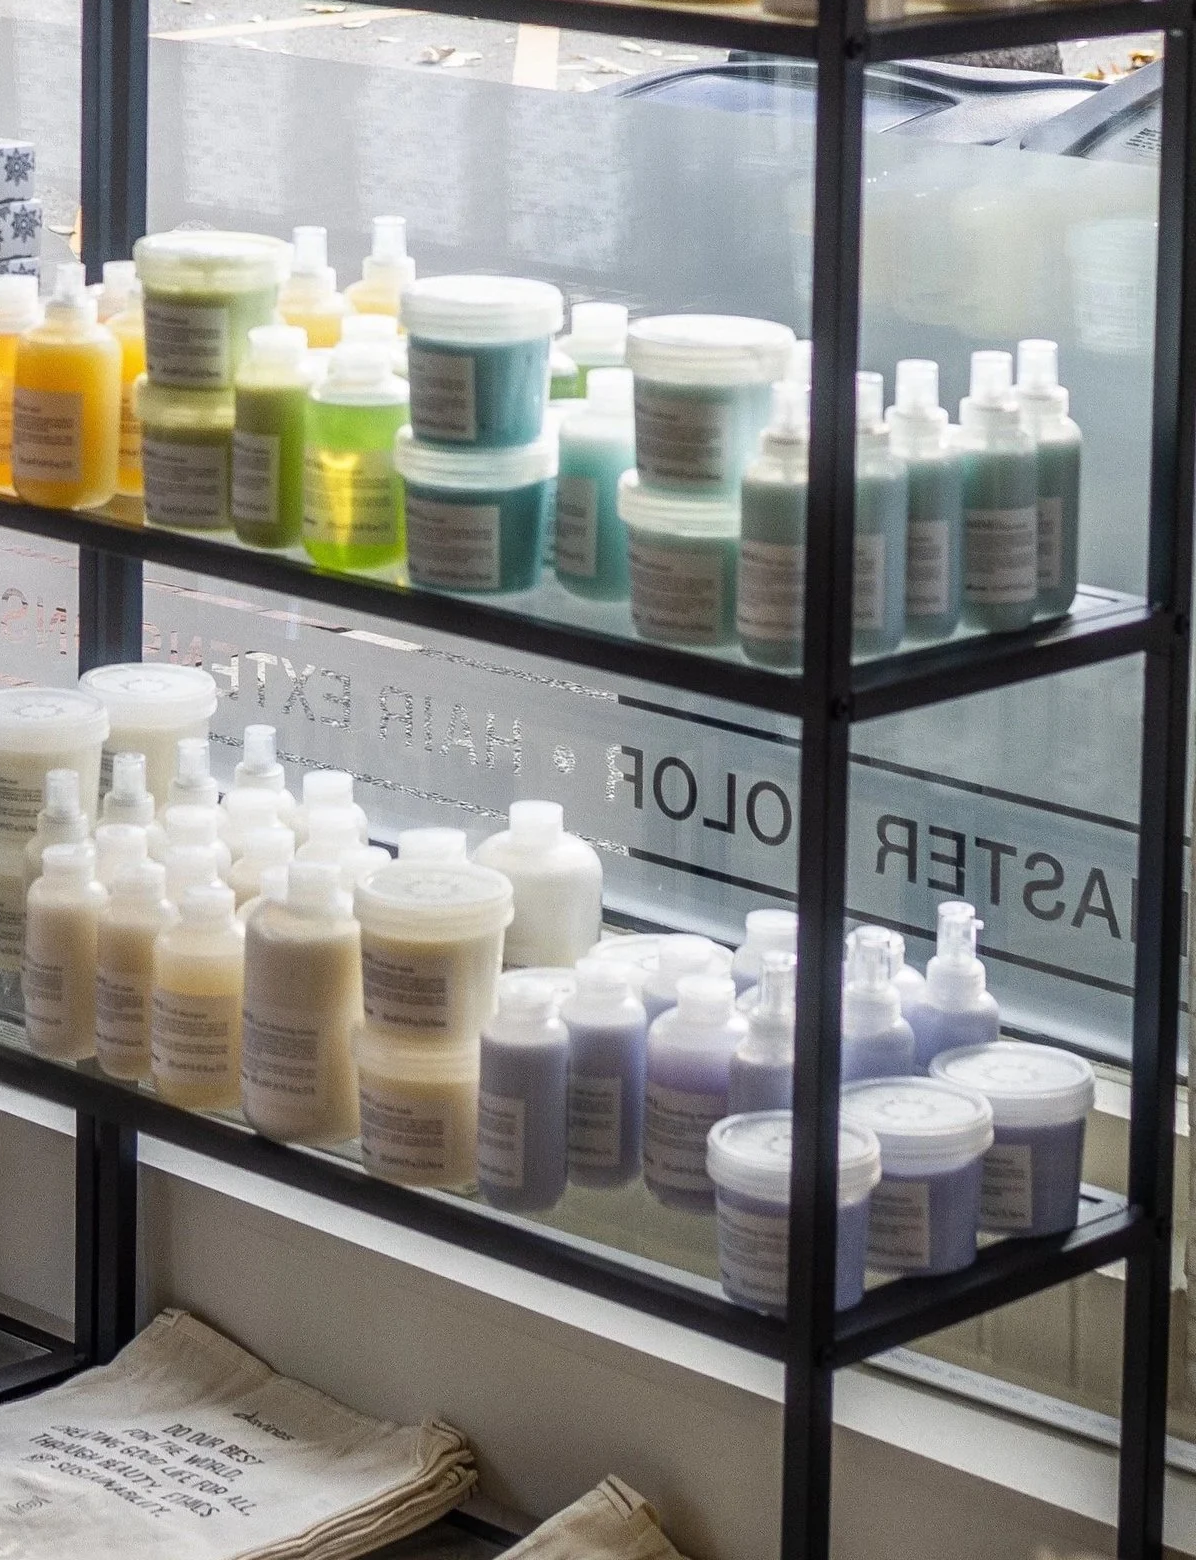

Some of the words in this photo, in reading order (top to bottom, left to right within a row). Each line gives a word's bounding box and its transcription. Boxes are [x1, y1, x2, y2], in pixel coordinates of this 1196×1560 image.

[29, 1433, 104, 1461] THROUGH
[162, 1423, 193, 1438] DO
[186, 1432, 225, 1448] OUR
[220, 1444, 266, 1465] BEST
[120, 1445, 167, 1466] GOOD
[161, 1466, 201, 1484] LIFE
[195, 1479, 229, 1495] FOR
